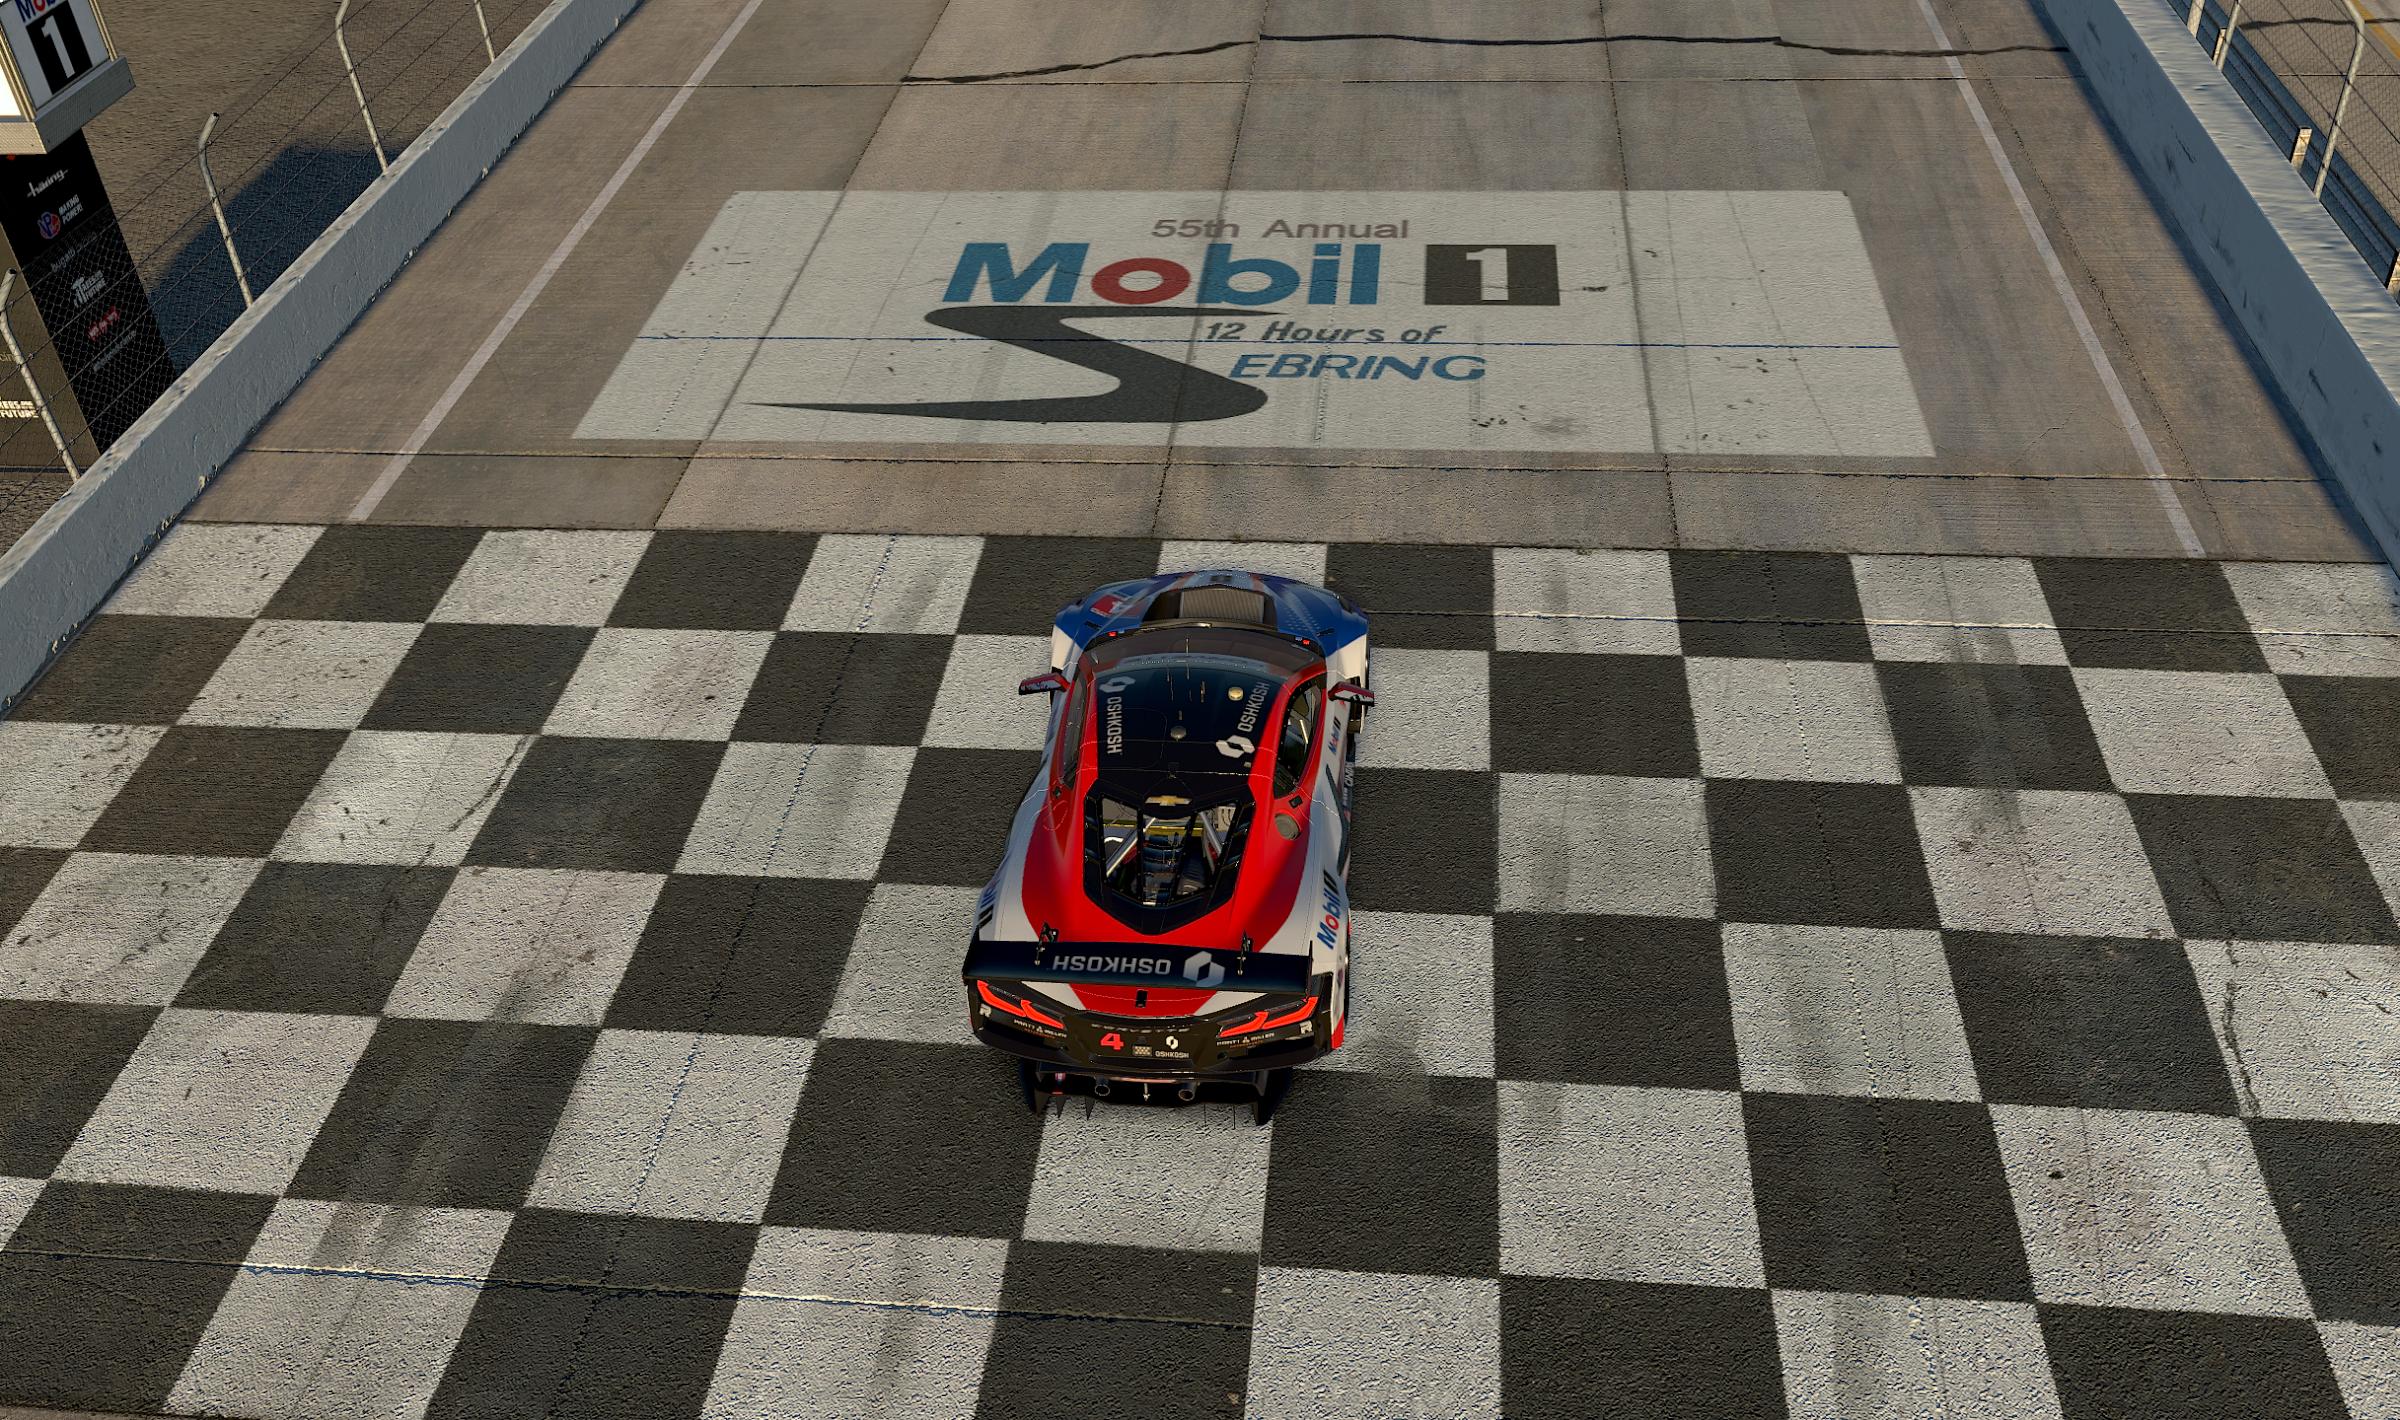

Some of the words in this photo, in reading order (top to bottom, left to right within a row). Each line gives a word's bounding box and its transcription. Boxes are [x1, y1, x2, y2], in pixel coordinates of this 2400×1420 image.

[41, 15, 76, 79] 1
[1151, 219, 1240, 238] 55th
[1262, 219, 1409, 239] Annual
[943, 242, 1382, 306] Mobil
[1207, 322, 1247, 340] 12
[1262, 321, 1385, 342] Hours
[1401, 325, 1447, 343] of
[1237, 681, 1270, 732] OSHKOSH
[1107, 696, 1122, 754] OSHKOSH
[1317, 887, 1342, 949] Mobil
[1052, 955, 1172, 975] OSHKOSH
[1100, 1033, 1124, 1050] 4
[1155, 1050, 1189, 1058] OSHKOSH
